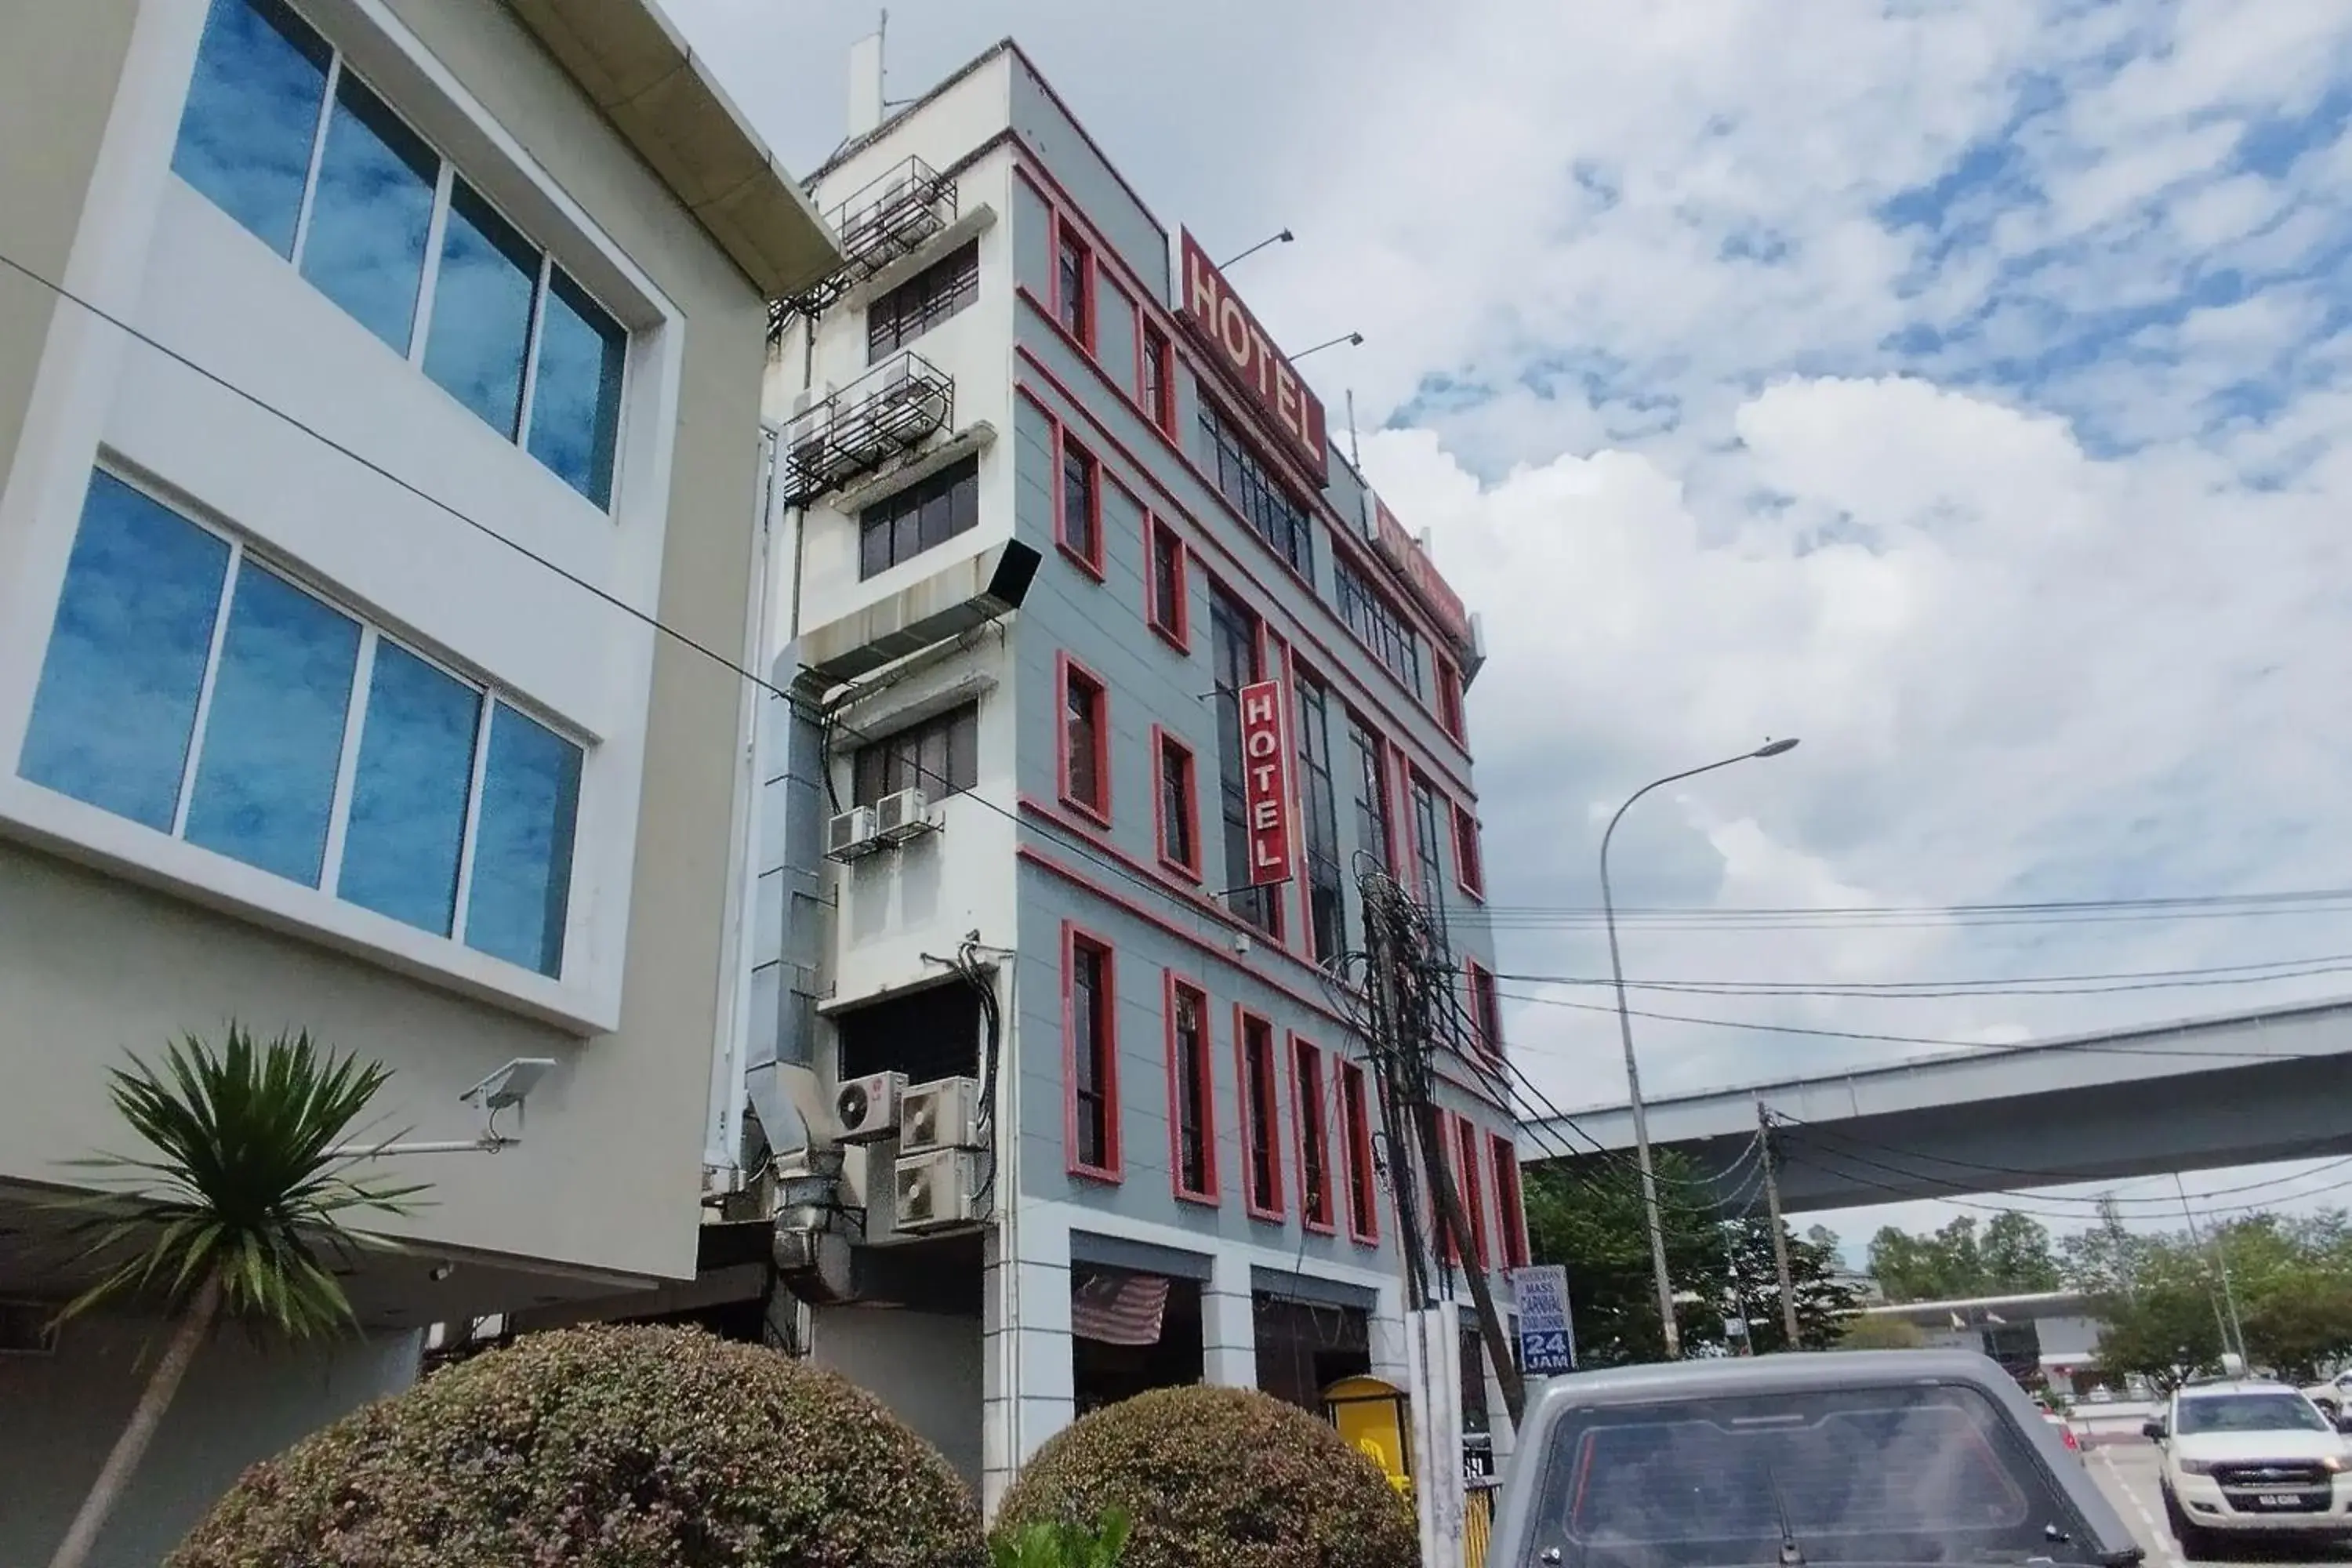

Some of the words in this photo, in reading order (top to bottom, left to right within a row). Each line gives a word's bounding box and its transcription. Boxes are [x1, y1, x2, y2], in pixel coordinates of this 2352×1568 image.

[1190, 252, 1320, 461] HOTEL
[1247, 695, 1282, 867] HOTEL
[1526, 1333, 1566, 1355] 24
[1528, 1355, 1569, 1369] JAM
